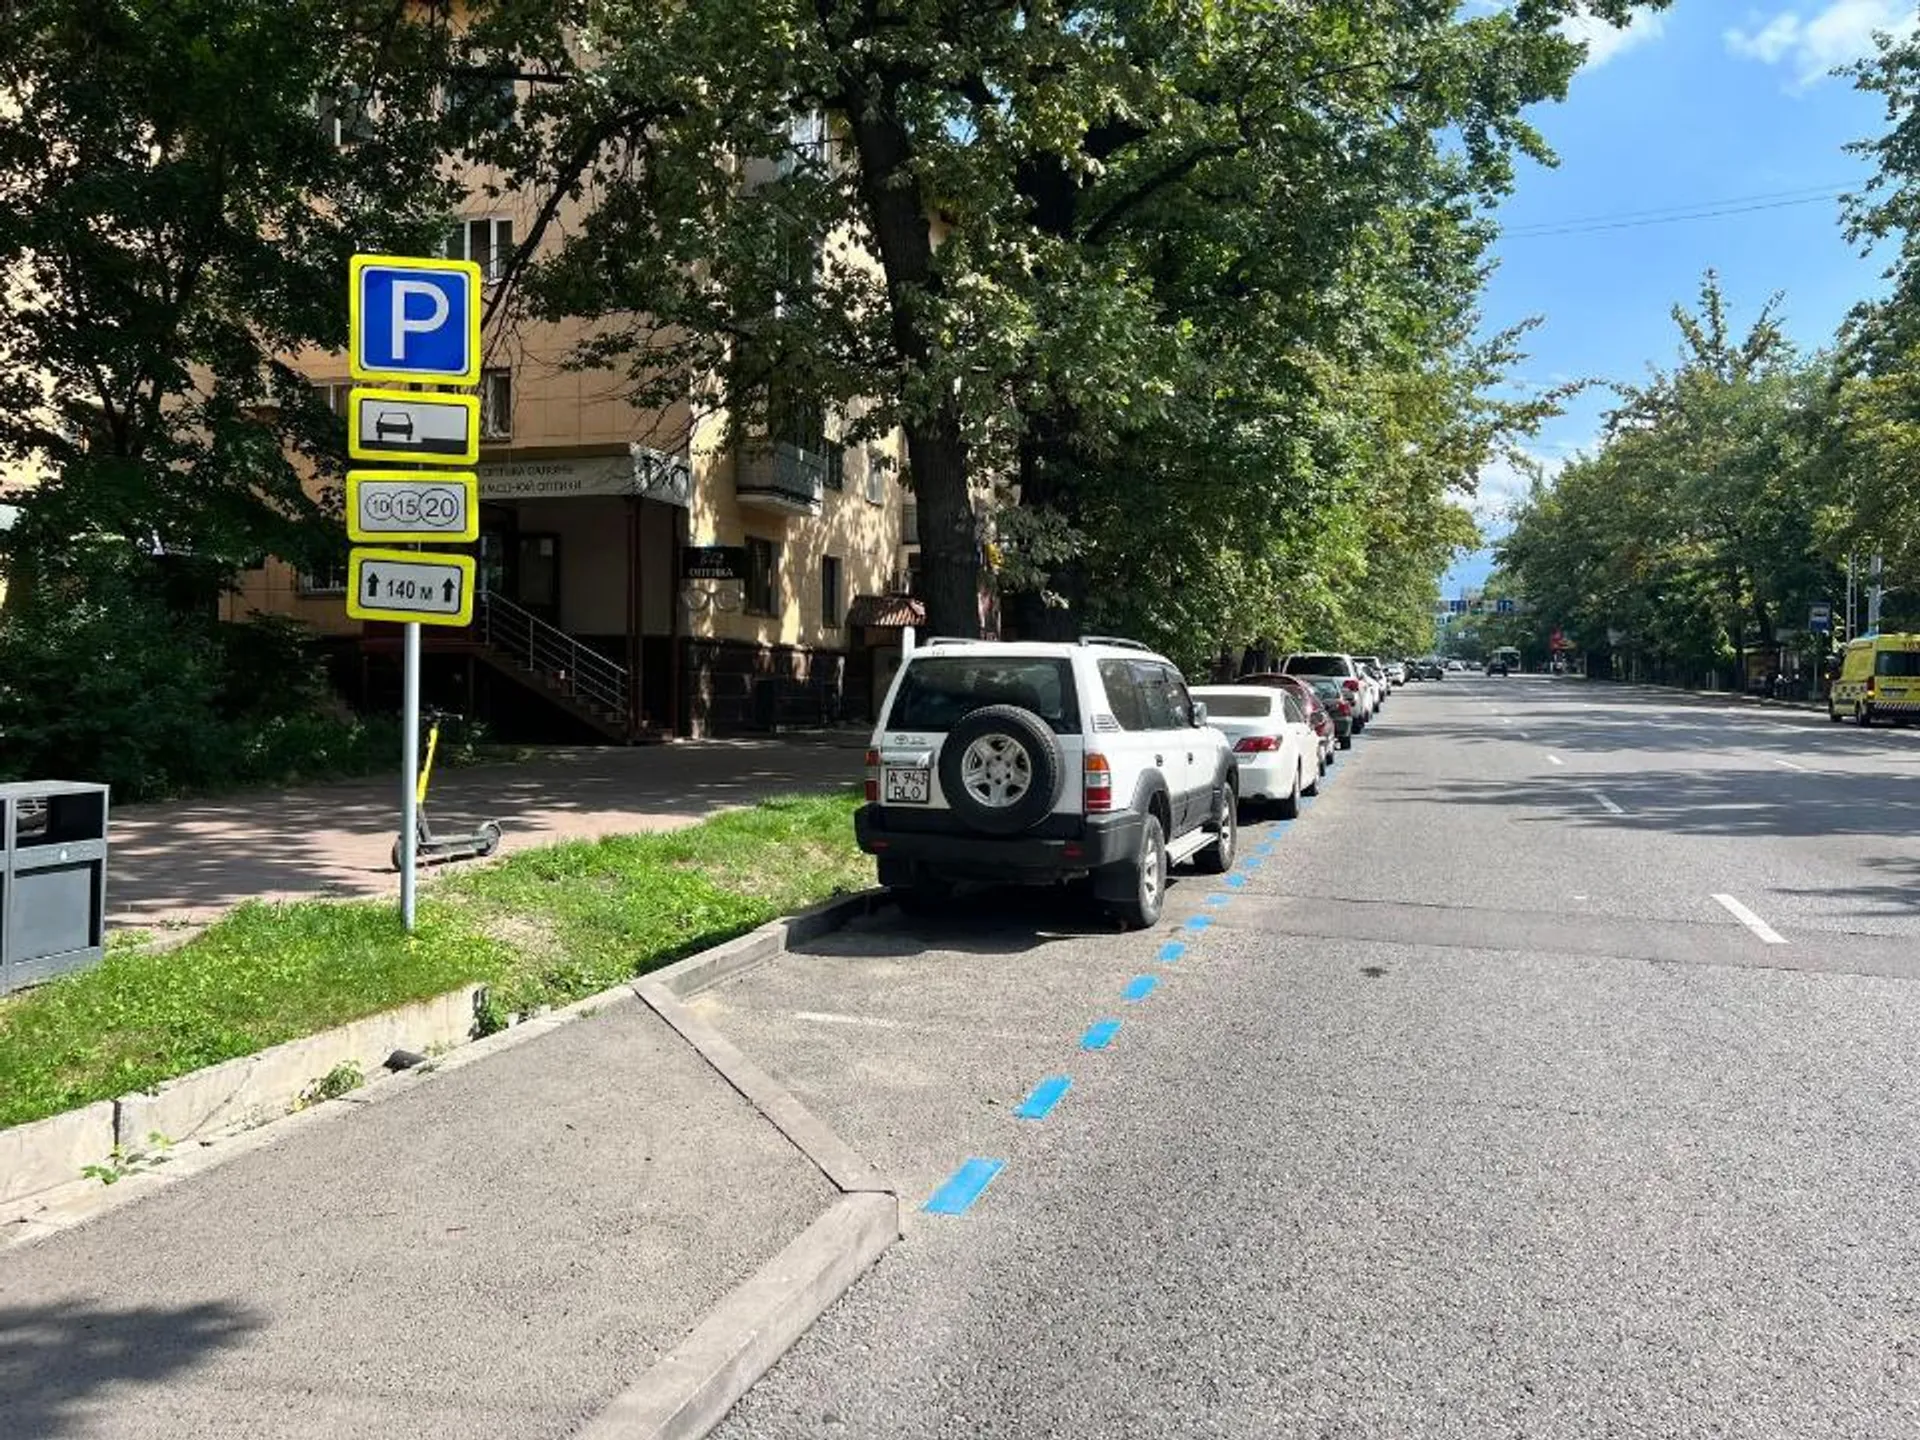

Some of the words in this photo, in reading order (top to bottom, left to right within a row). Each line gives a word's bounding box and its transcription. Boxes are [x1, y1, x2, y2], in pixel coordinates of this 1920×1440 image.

[391, 279, 450, 360] P
[372, 499, 390, 514] 10
[396, 499, 418, 516] 15
[426, 497, 455, 518] 20
[688, 567, 734, 578] ОПТИКА
[387, 579, 416, 600] 140
[894, 786, 922, 800] RLO
